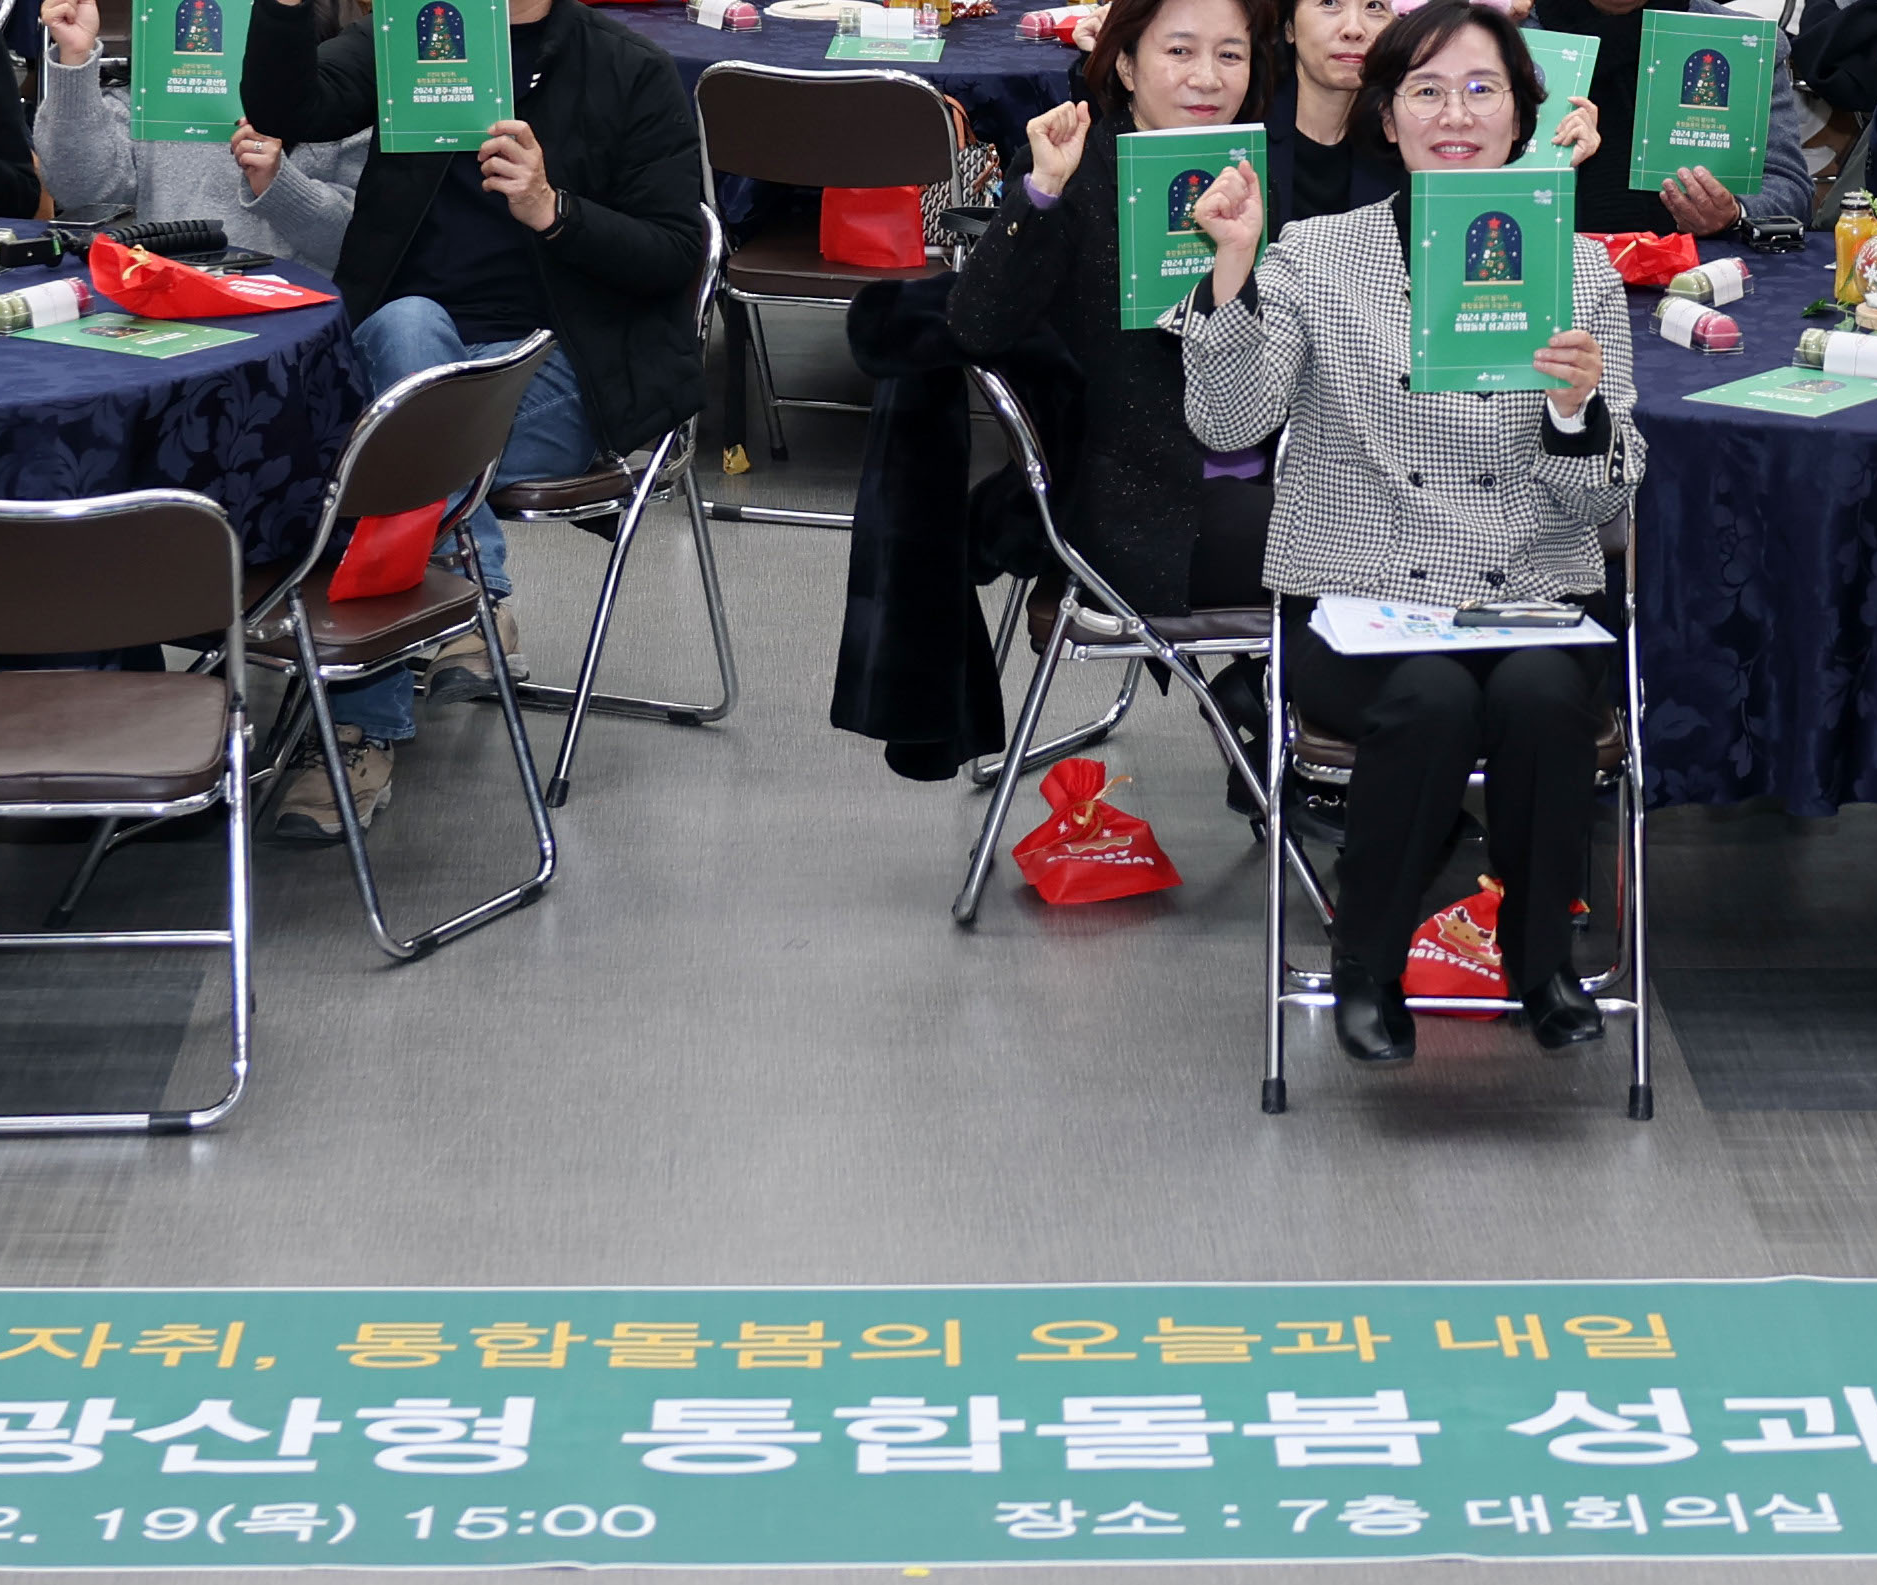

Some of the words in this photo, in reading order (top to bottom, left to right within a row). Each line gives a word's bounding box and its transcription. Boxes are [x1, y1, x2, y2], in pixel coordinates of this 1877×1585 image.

[413, 87, 432, 95] 2024
[1456, 312, 1480, 322] 2024
[335, 1319, 963, 1371] 통합돌봄의
[1018, 1316, 1390, 1367] 오늘과
[1433, 1313, 1677, 1361] 내일
[622, 1387, 1441, 1474] 통합돌봄
[90, 1502, 357, 1544] 19(목)
[404, 1502, 657, 1541] 15:00
[991, 1495, 1189, 1540] 장소
[1290, 1495, 1428, 1536] 7층
[1465, 1493, 1843, 1536] 대회의실
